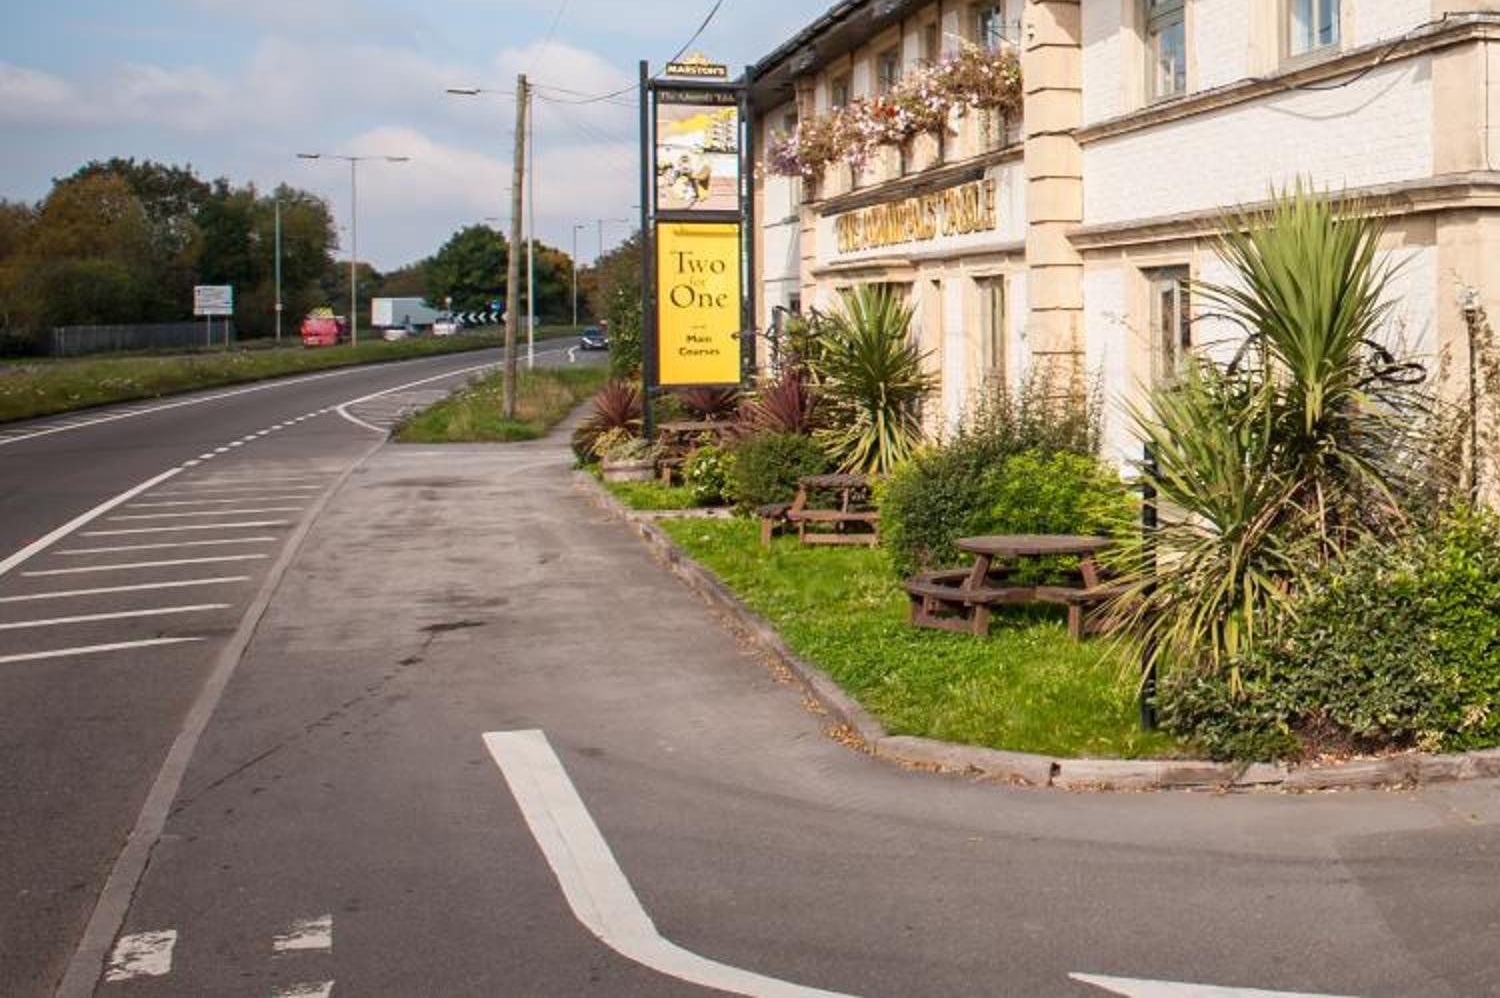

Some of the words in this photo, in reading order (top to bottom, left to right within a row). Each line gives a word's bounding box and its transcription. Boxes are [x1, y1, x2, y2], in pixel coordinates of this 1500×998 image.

[667, 64, 724, 75] MARSTON'S
[670, 250, 726, 274] Two
[669, 284, 728, 308] One
[679, 347, 720, 356] Courses
